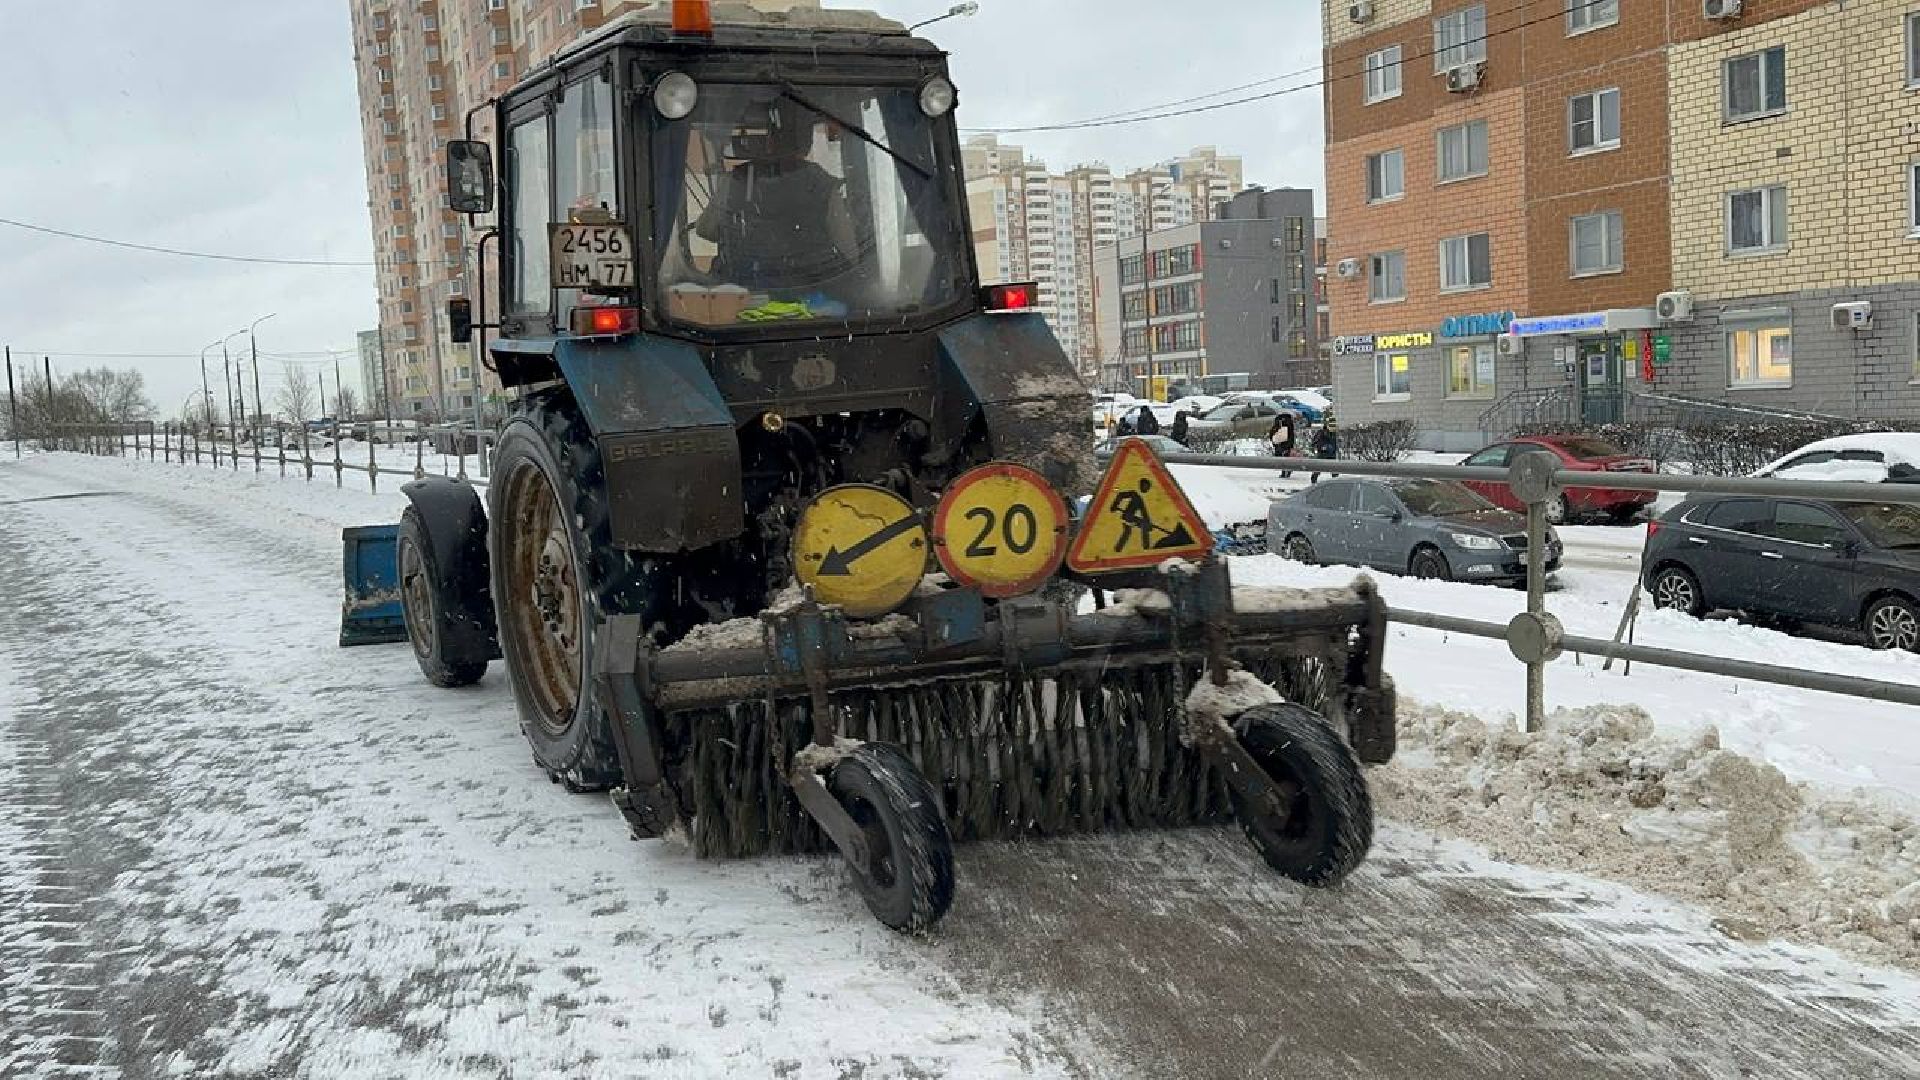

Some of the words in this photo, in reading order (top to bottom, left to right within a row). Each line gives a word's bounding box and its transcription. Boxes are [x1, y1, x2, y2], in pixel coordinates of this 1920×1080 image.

[561, 228, 622, 253] 2456
[603, 263, 628, 283] 77
[1377, 333, 1432, 349] ЮРИСТЫ
[965, 504, 1036, 557] 20
